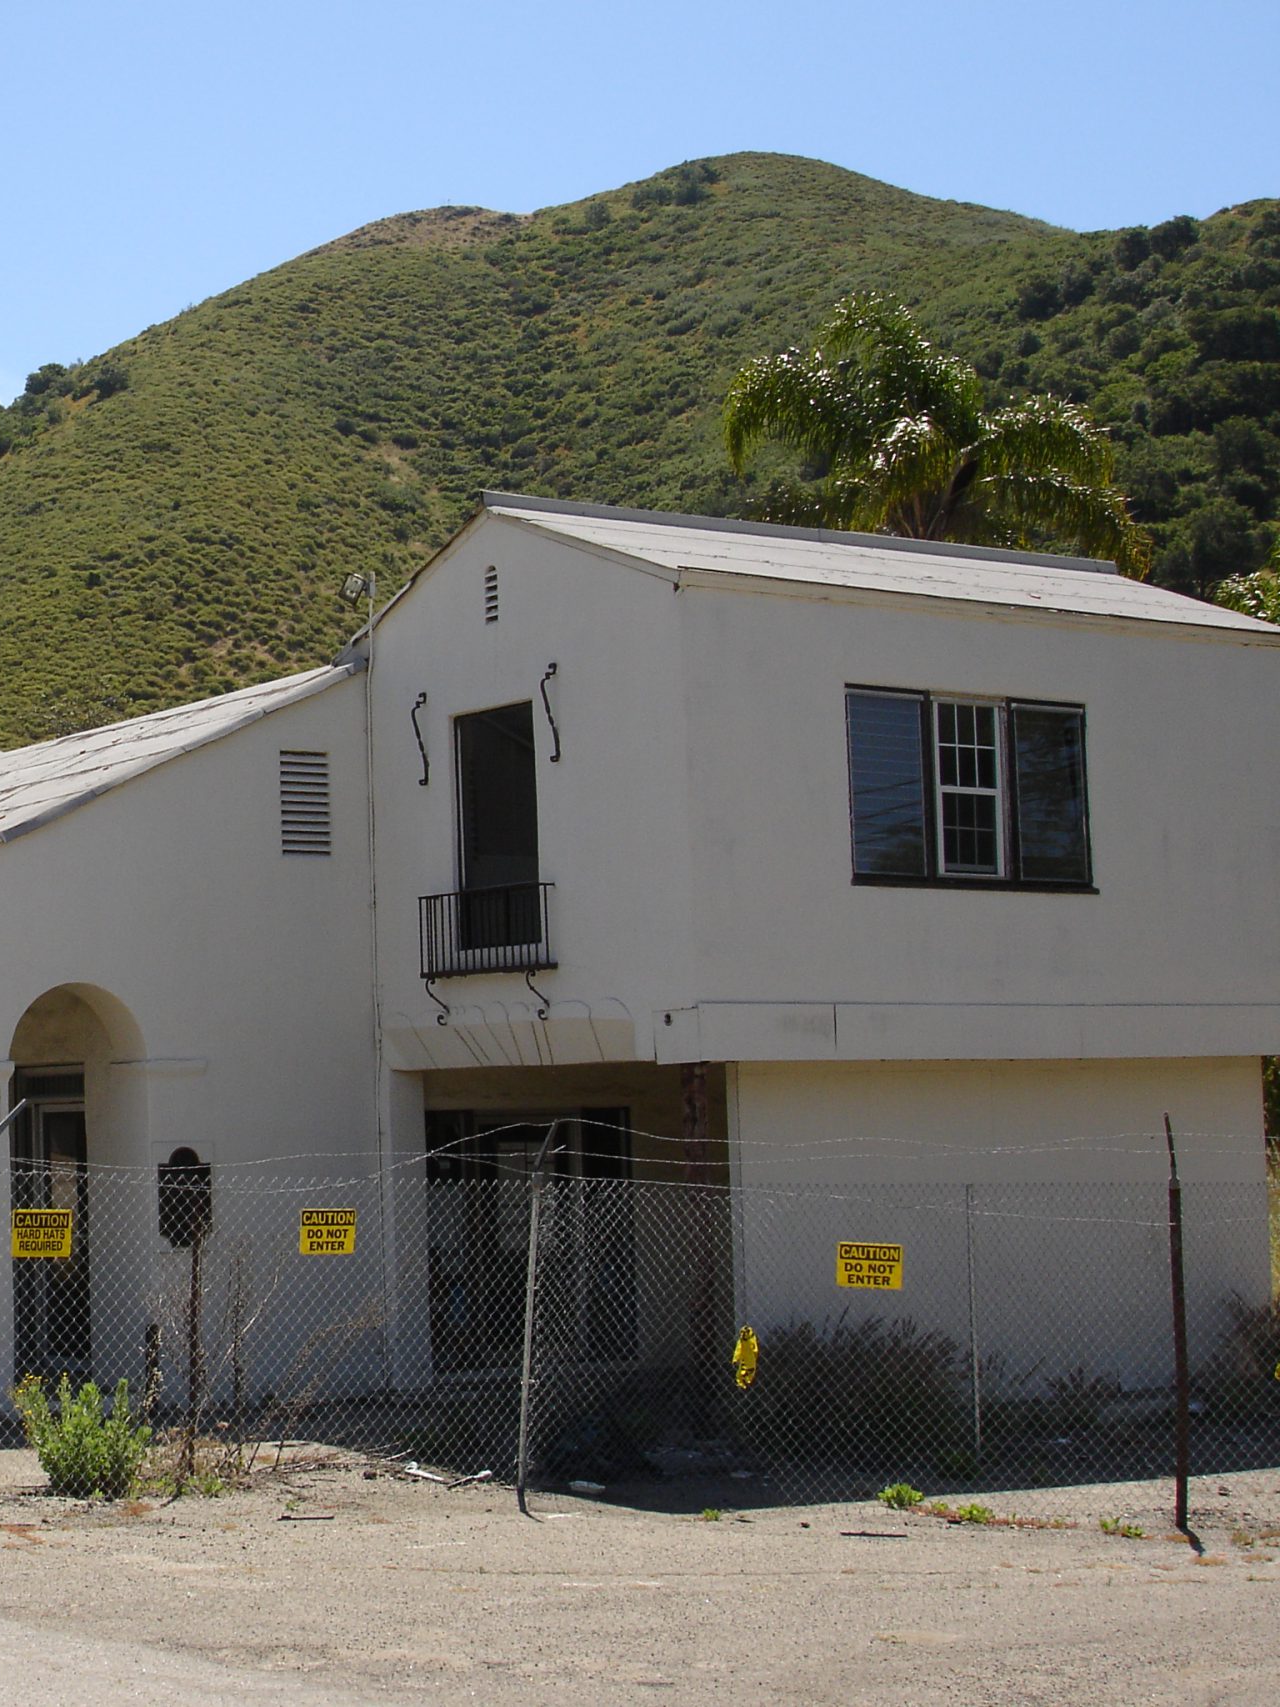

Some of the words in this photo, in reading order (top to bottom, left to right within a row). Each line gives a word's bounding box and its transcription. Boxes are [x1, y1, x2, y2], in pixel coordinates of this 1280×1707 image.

[16, 1214, 68, 1227] CAUTION
[303, 1212, 354, 1225] CAUTION
[17, 1229, 41, 1240] HARD
[43, 1229, 65, 1240] HATS
[307, 1228, 323, 1239] DO
[326, 1228, 349, 1239] NOT
[19, 1240, 63, 1251] REQUIRED
[309, 1241, 345, 1251] ENTER
[841, 1246, 899, 1260] CAUTION
[844, 1262, 863, 1273] DO
[868, 1264, 895, 1274] NOT
[847, 1274, 891, 1286] ENTER
